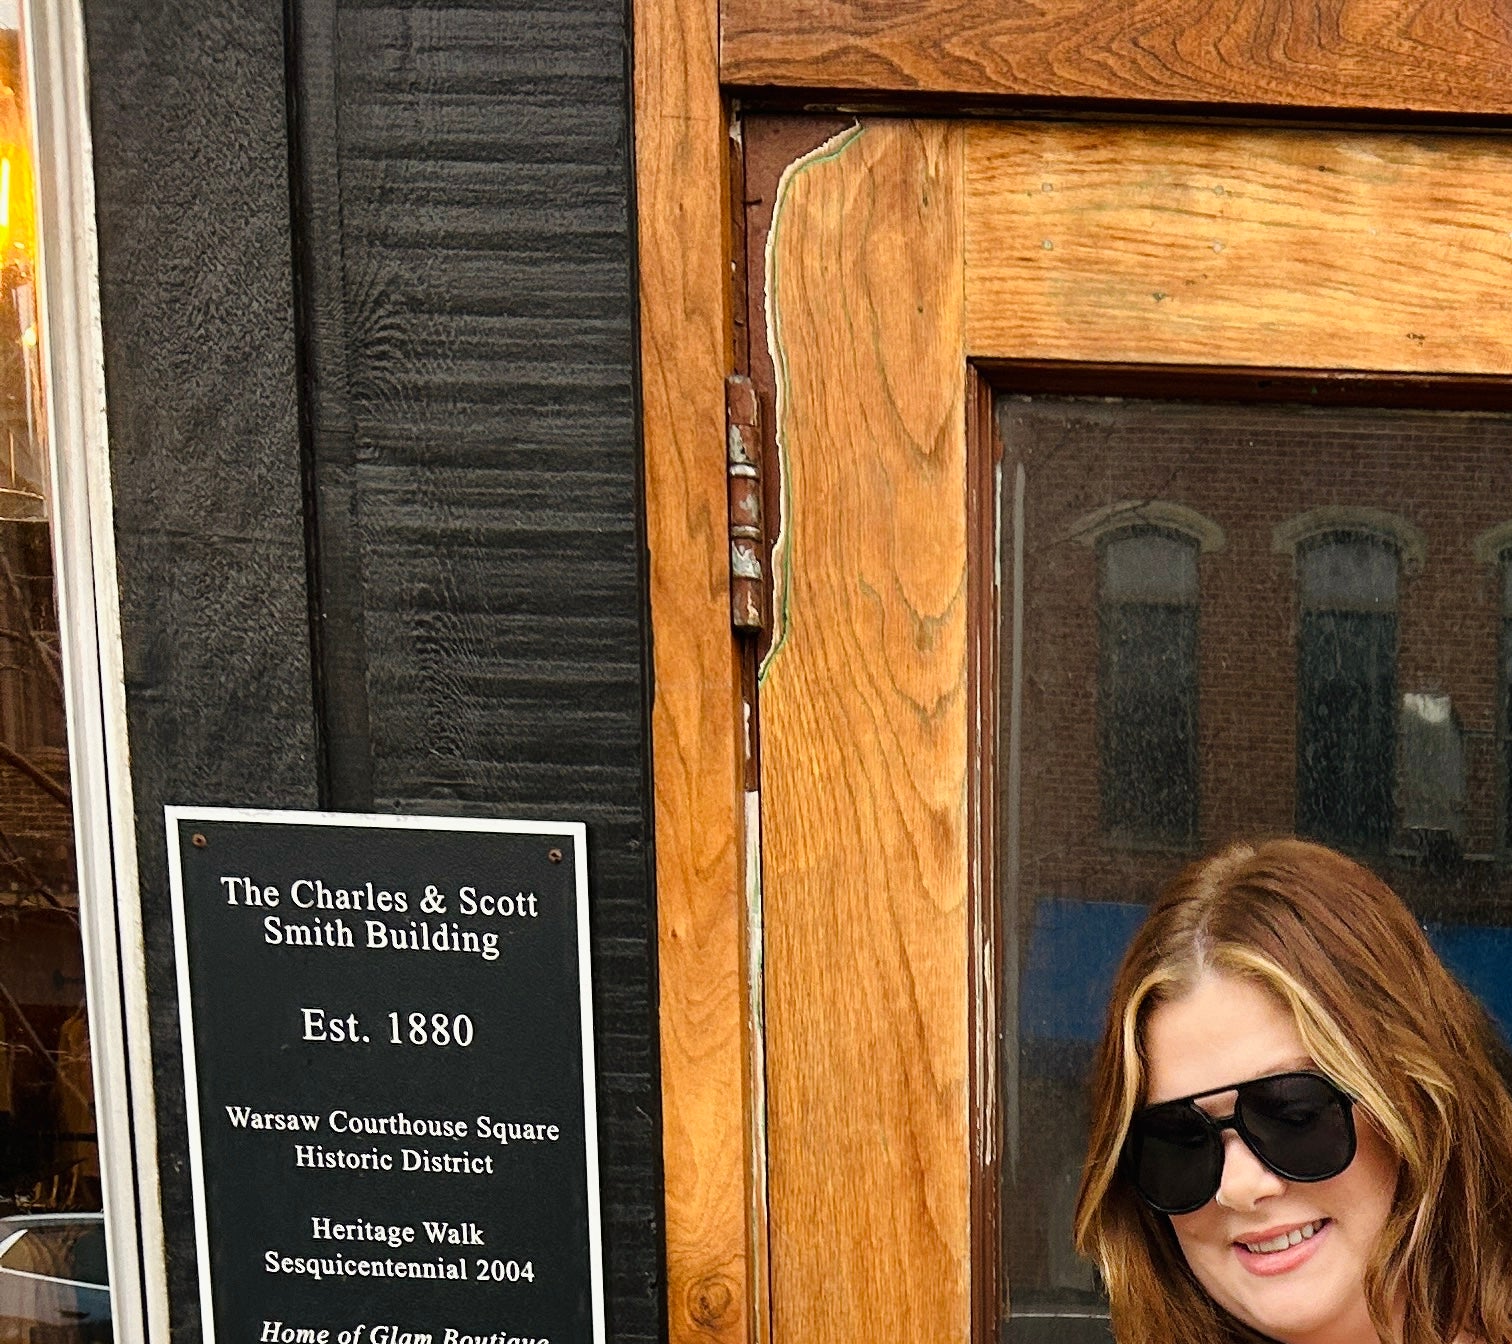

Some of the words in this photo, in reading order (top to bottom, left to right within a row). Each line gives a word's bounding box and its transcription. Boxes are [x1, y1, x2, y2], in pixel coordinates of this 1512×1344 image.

[221, 877, 280, 907] The
[290, 880, 408, 913] Charles
[420, 885, 447, 914] &
[460, 887, 538, 918] Scott
[265, 916, 354, 947] Smith
[365, 921, 500, 961] Building
[301, 1009, 370, 1043] Est.
[388, 1012, 474, 1047] 1880
[225, 1106, 320, 1132] Warsaw
[328, 1111, 468, 1138] Courthouse
[476, 1117, 560, 1145] Square
[295, 1145, 393, 1171] Historic
[401, 1149, 494, 1174] District
[311, 1217, 415, 1247] Heritage
[422, 1222, 485, 1246] Walk
[264, 1250, 468, 1281] Sesquicentennial
[476, 1259, 535, 1283] 2004
